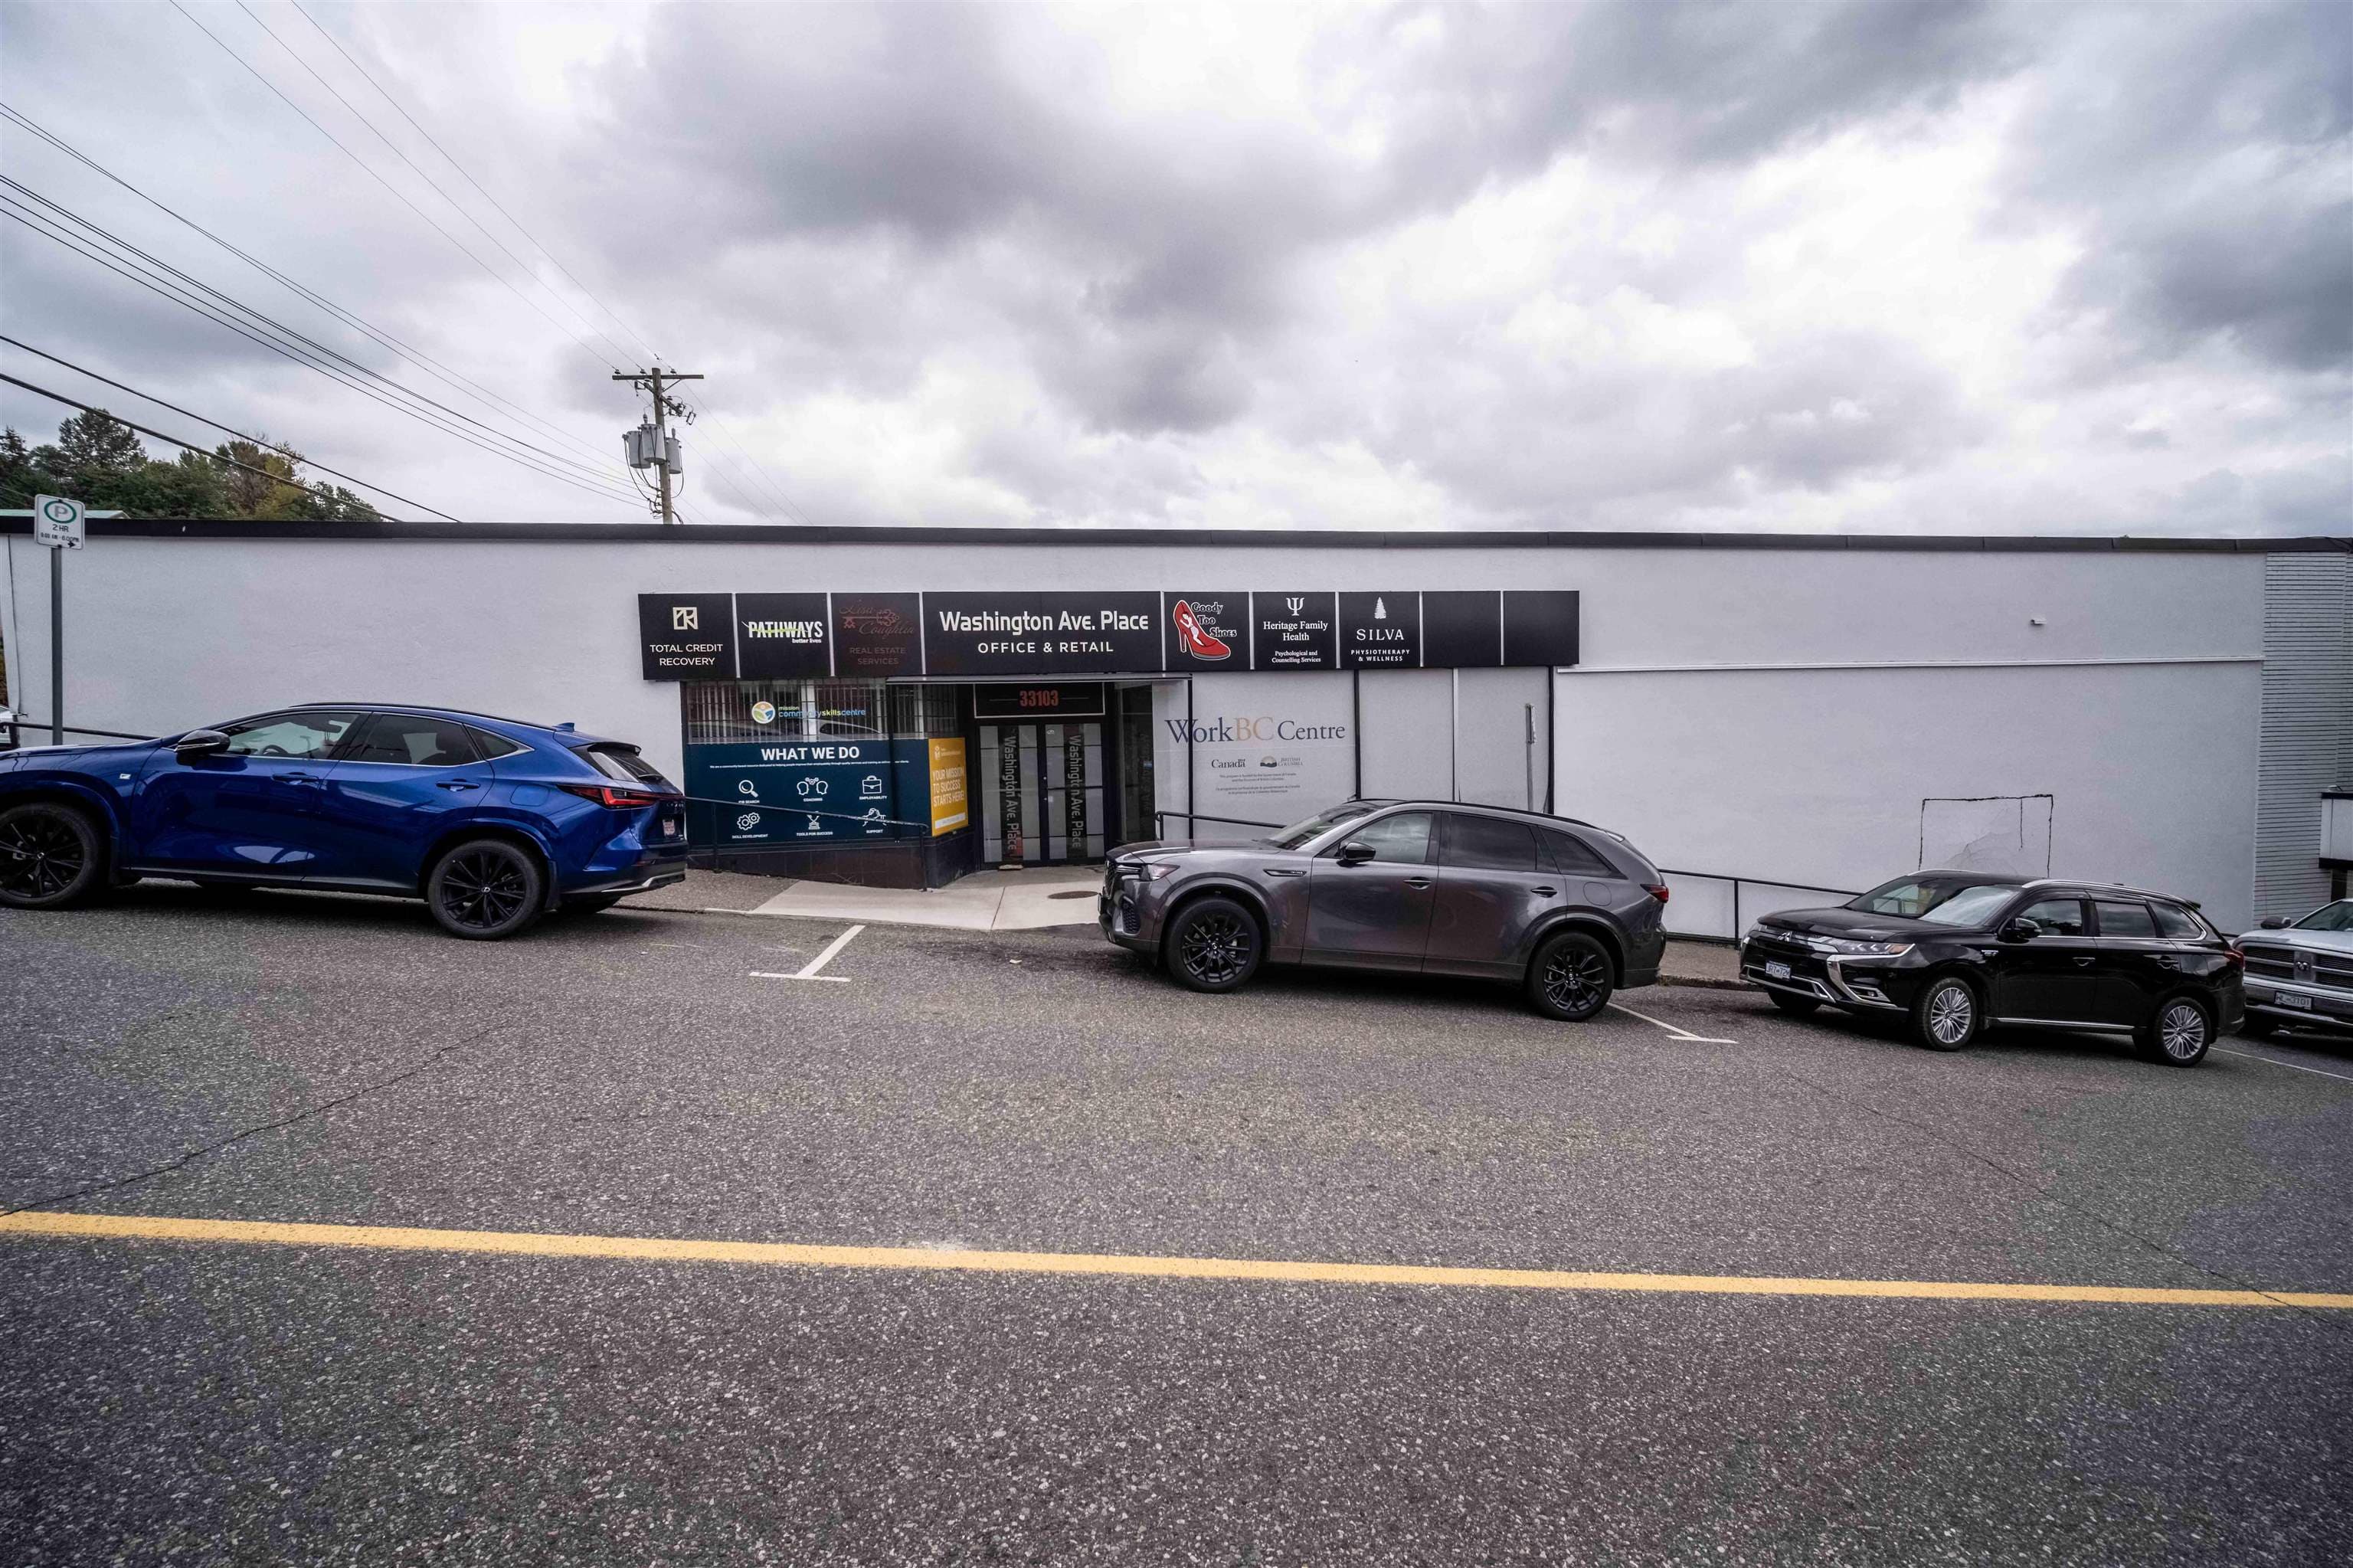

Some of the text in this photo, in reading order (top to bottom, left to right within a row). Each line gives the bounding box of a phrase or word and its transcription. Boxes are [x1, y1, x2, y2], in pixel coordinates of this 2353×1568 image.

[54, 505, 67, 518] P
[1191, 601, 1224, 614] Goody
[939, 610, 1149, 636] Washington Ave. Place
[1196, 614, 1216, 624] Too
[748, 620, 823, 638] PATHWAYS
[1263, 620, 1328, 632] Heritage Family
[1282, 632, 1310, 641] Health
[1356, 628, 1405, 640] SILVA
[649, 643, 724, 653] TOTAL CREDIT
[977, 641, 1114, 653] OFFICE & RETAIL
[659, 657, 715, 666] RECOVERY
[1019, 689, 1059, 707] 33103
[1277, 720, 1346, 741] Centre
[761, 746, 860, 761] WHAT WE DO
[1211, 758, 1246, 768] Canada
[932, 769, 945, 781] YOUR
[1003, 736, 1020, 850] Washington Ave. Place
[1072, 820, 1084, 848] Place
